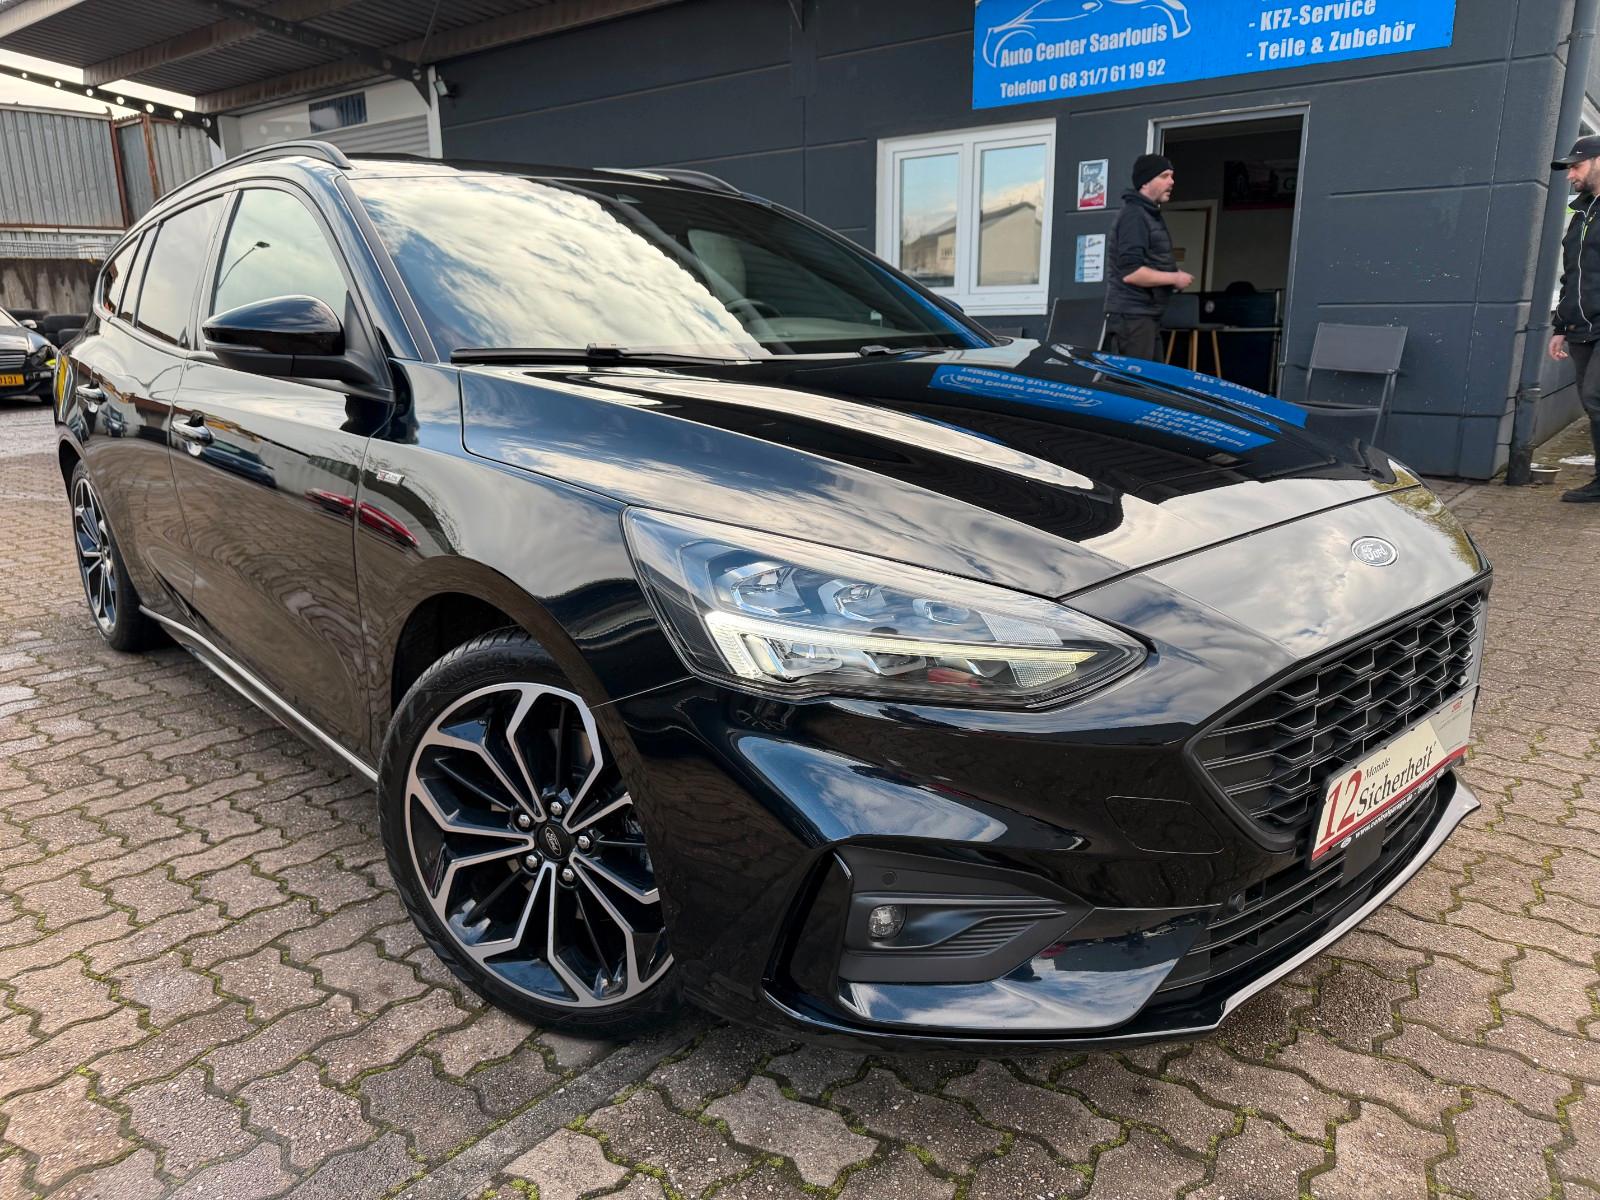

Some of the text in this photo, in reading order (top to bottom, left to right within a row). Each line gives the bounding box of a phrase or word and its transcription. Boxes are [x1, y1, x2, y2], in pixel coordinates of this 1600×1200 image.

[1260, 0, 1377, 31] KFZ-Service
[1000, 22, 1168, 68] Auto Center Saarlouis
[1258, 37, 1306, 61] Teile
[1310, 36, 1325, 54] &
[1328, 20, 1417, 52] Zubehör
[1000, 58, 1167, 98] Telefon 0 68 31/7 61 19 92
[1364, 757, 1391, 780] Monate
[1319, 745, 1433, 844] 12 Sicherheit
